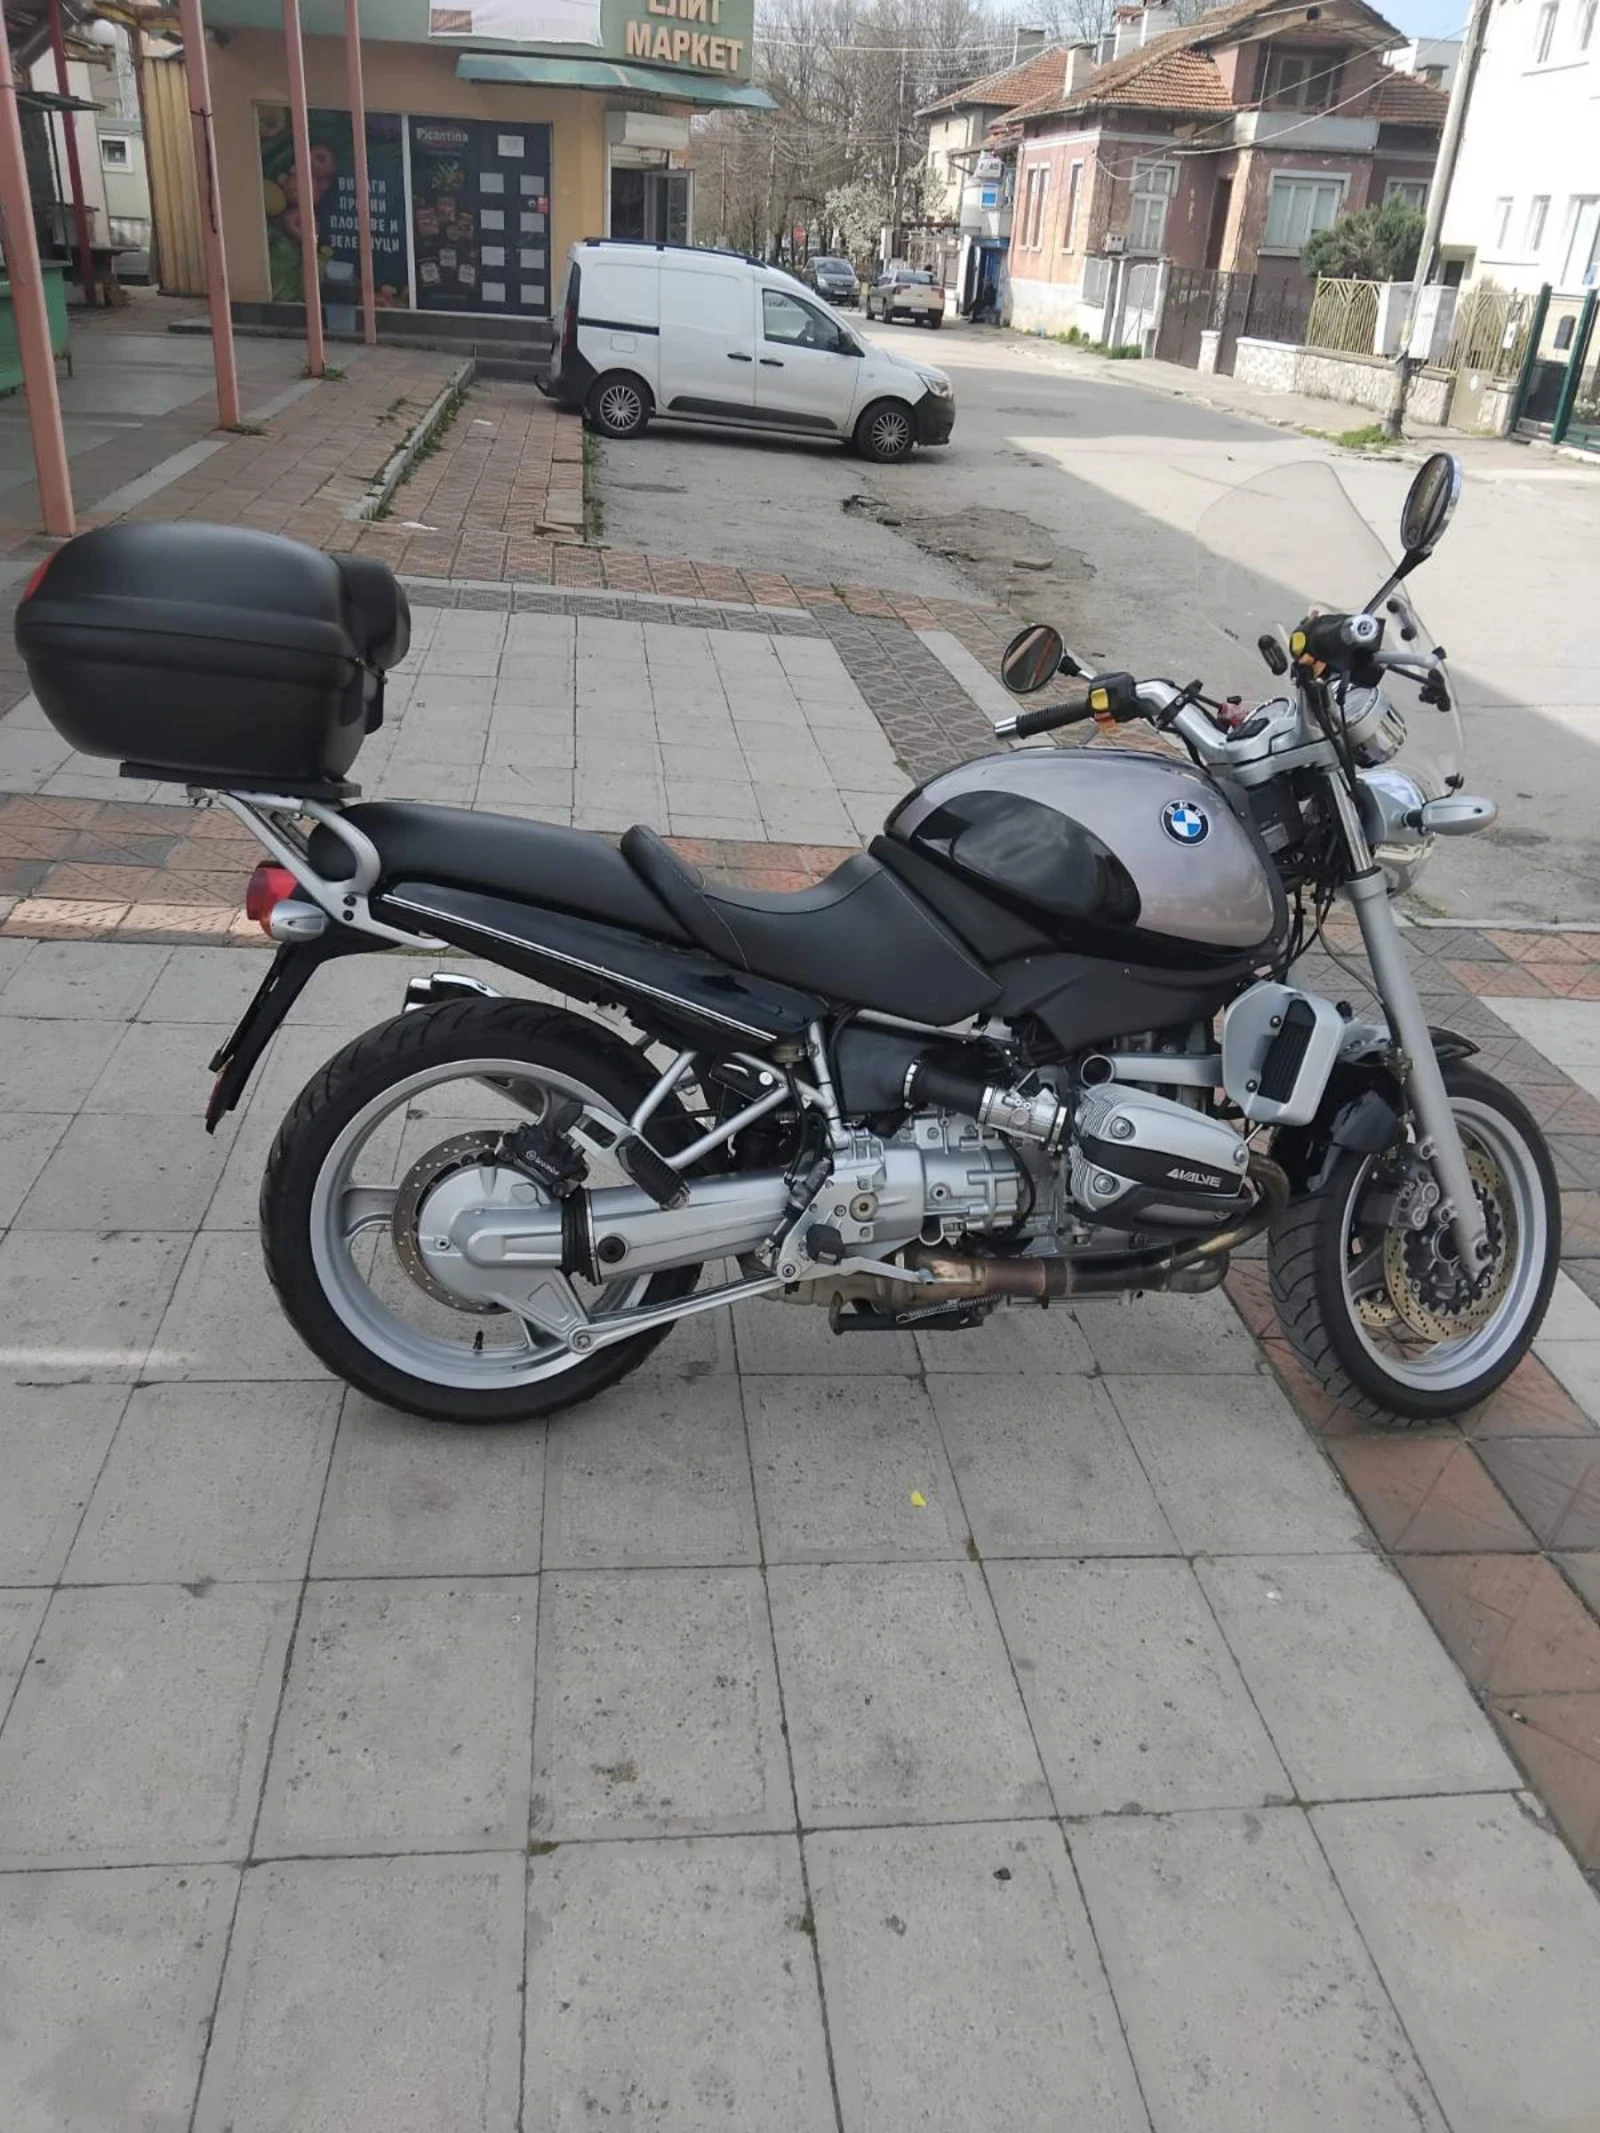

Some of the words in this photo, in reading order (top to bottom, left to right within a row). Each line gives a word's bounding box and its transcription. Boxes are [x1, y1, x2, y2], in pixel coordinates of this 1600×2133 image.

[626, 20, 743, 71] МАРКЕТ
[338, 177, 386, 193] ВИГИ
[339, 196, 386, 213] ПРНИ
[330, 215, 385, 232] ПЛОВЕ
[390, 218, 398, 233] И
[330, 234, 399, 254] ЗЕЛЕУЦИ
[1166, 1168, 1222, 1188] 4VALVE
